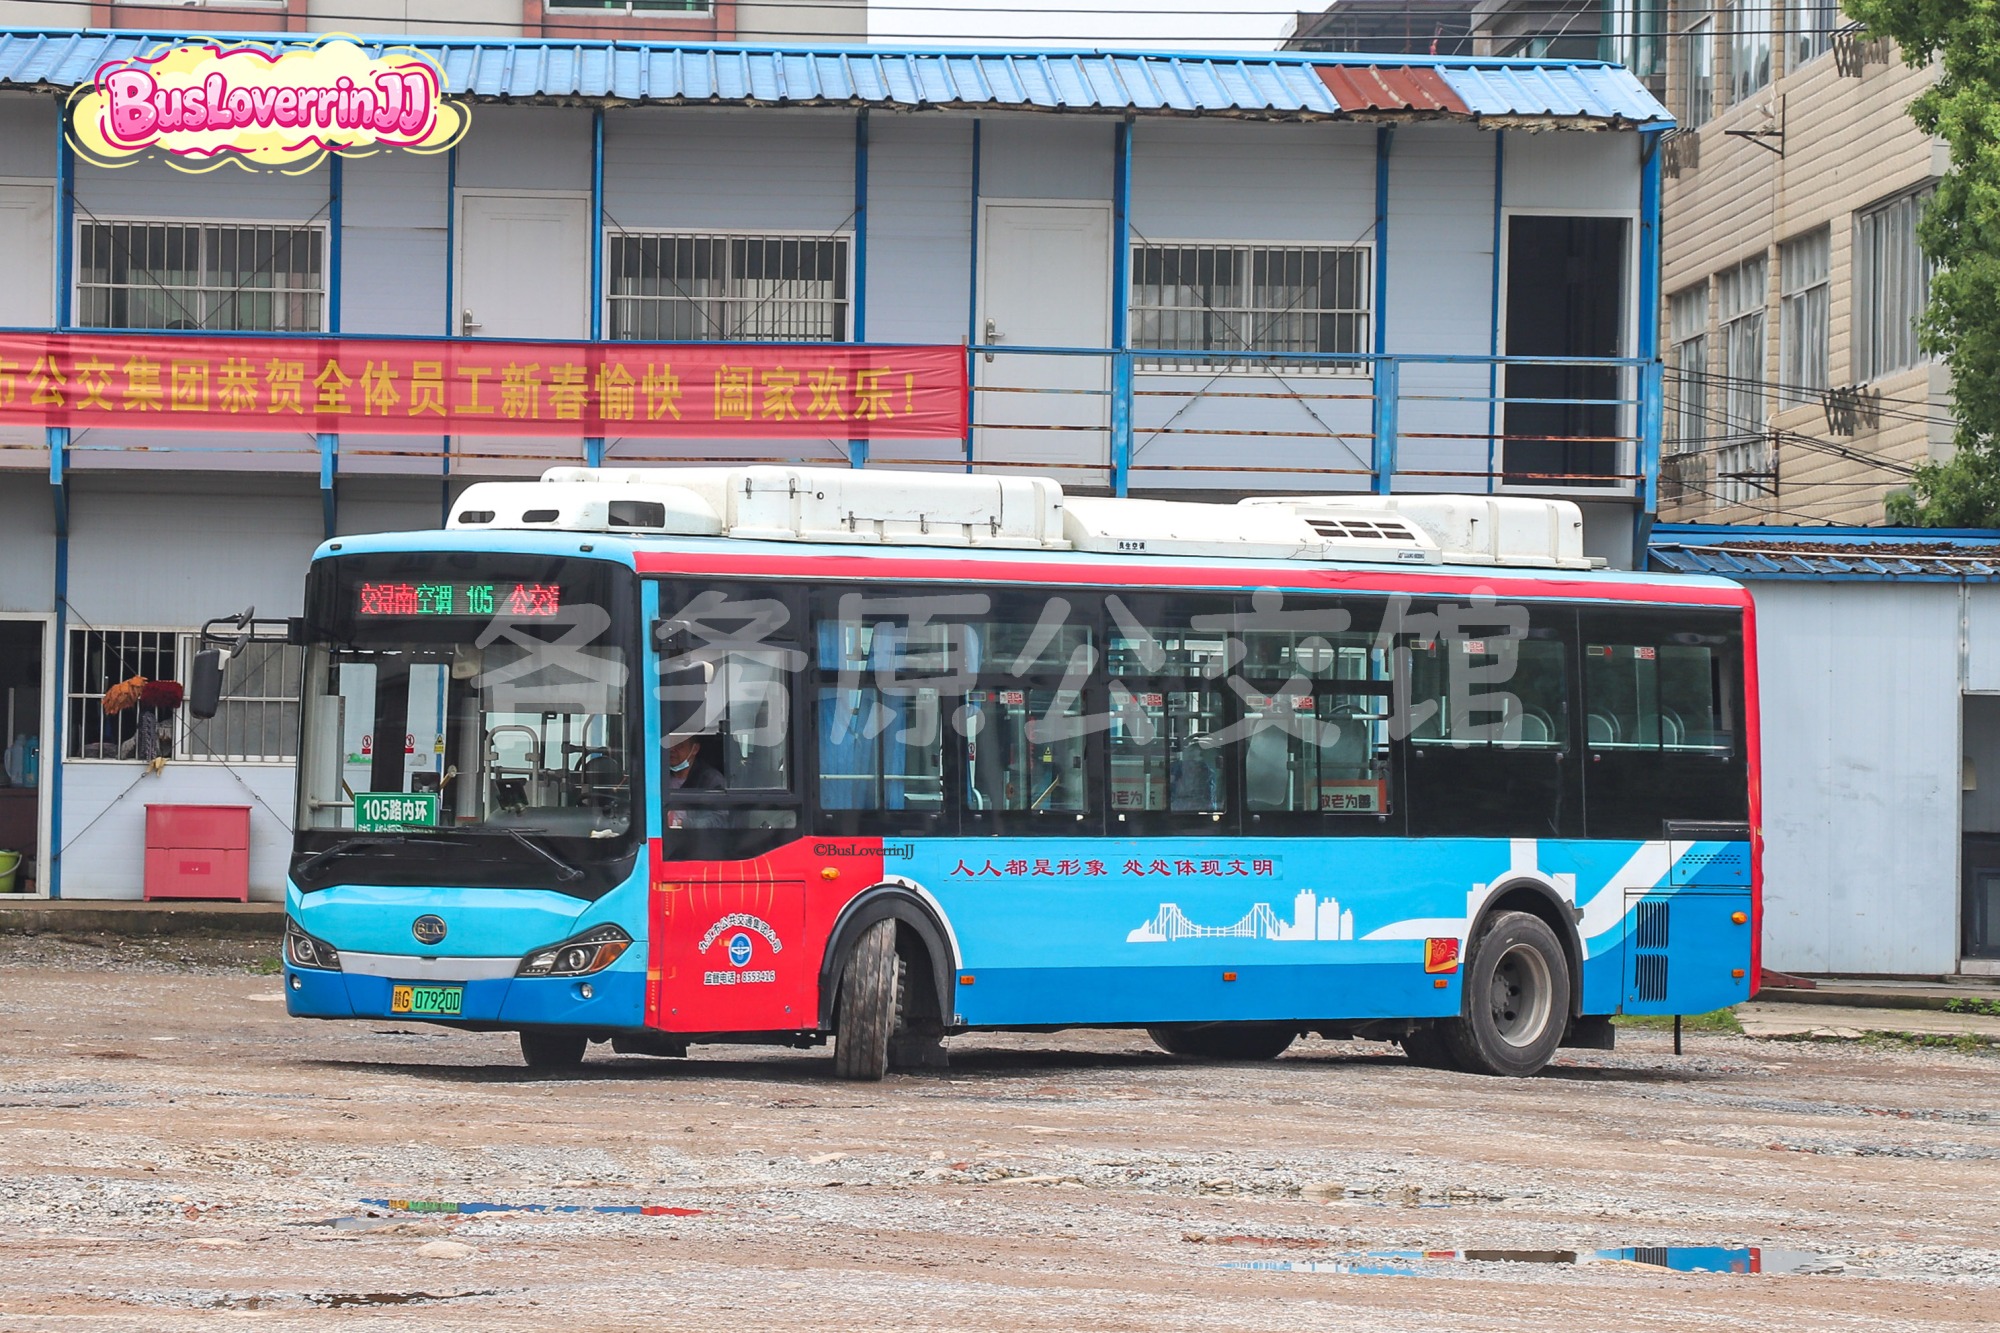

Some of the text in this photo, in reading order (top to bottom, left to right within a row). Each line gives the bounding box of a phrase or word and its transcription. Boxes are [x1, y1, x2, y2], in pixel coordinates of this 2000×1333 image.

[467, 585, 493, 613] 105
[363, 799, 428, 821] 105路内环
[950, 858, 1273, 877] 人人都是形象 处处体现文明
